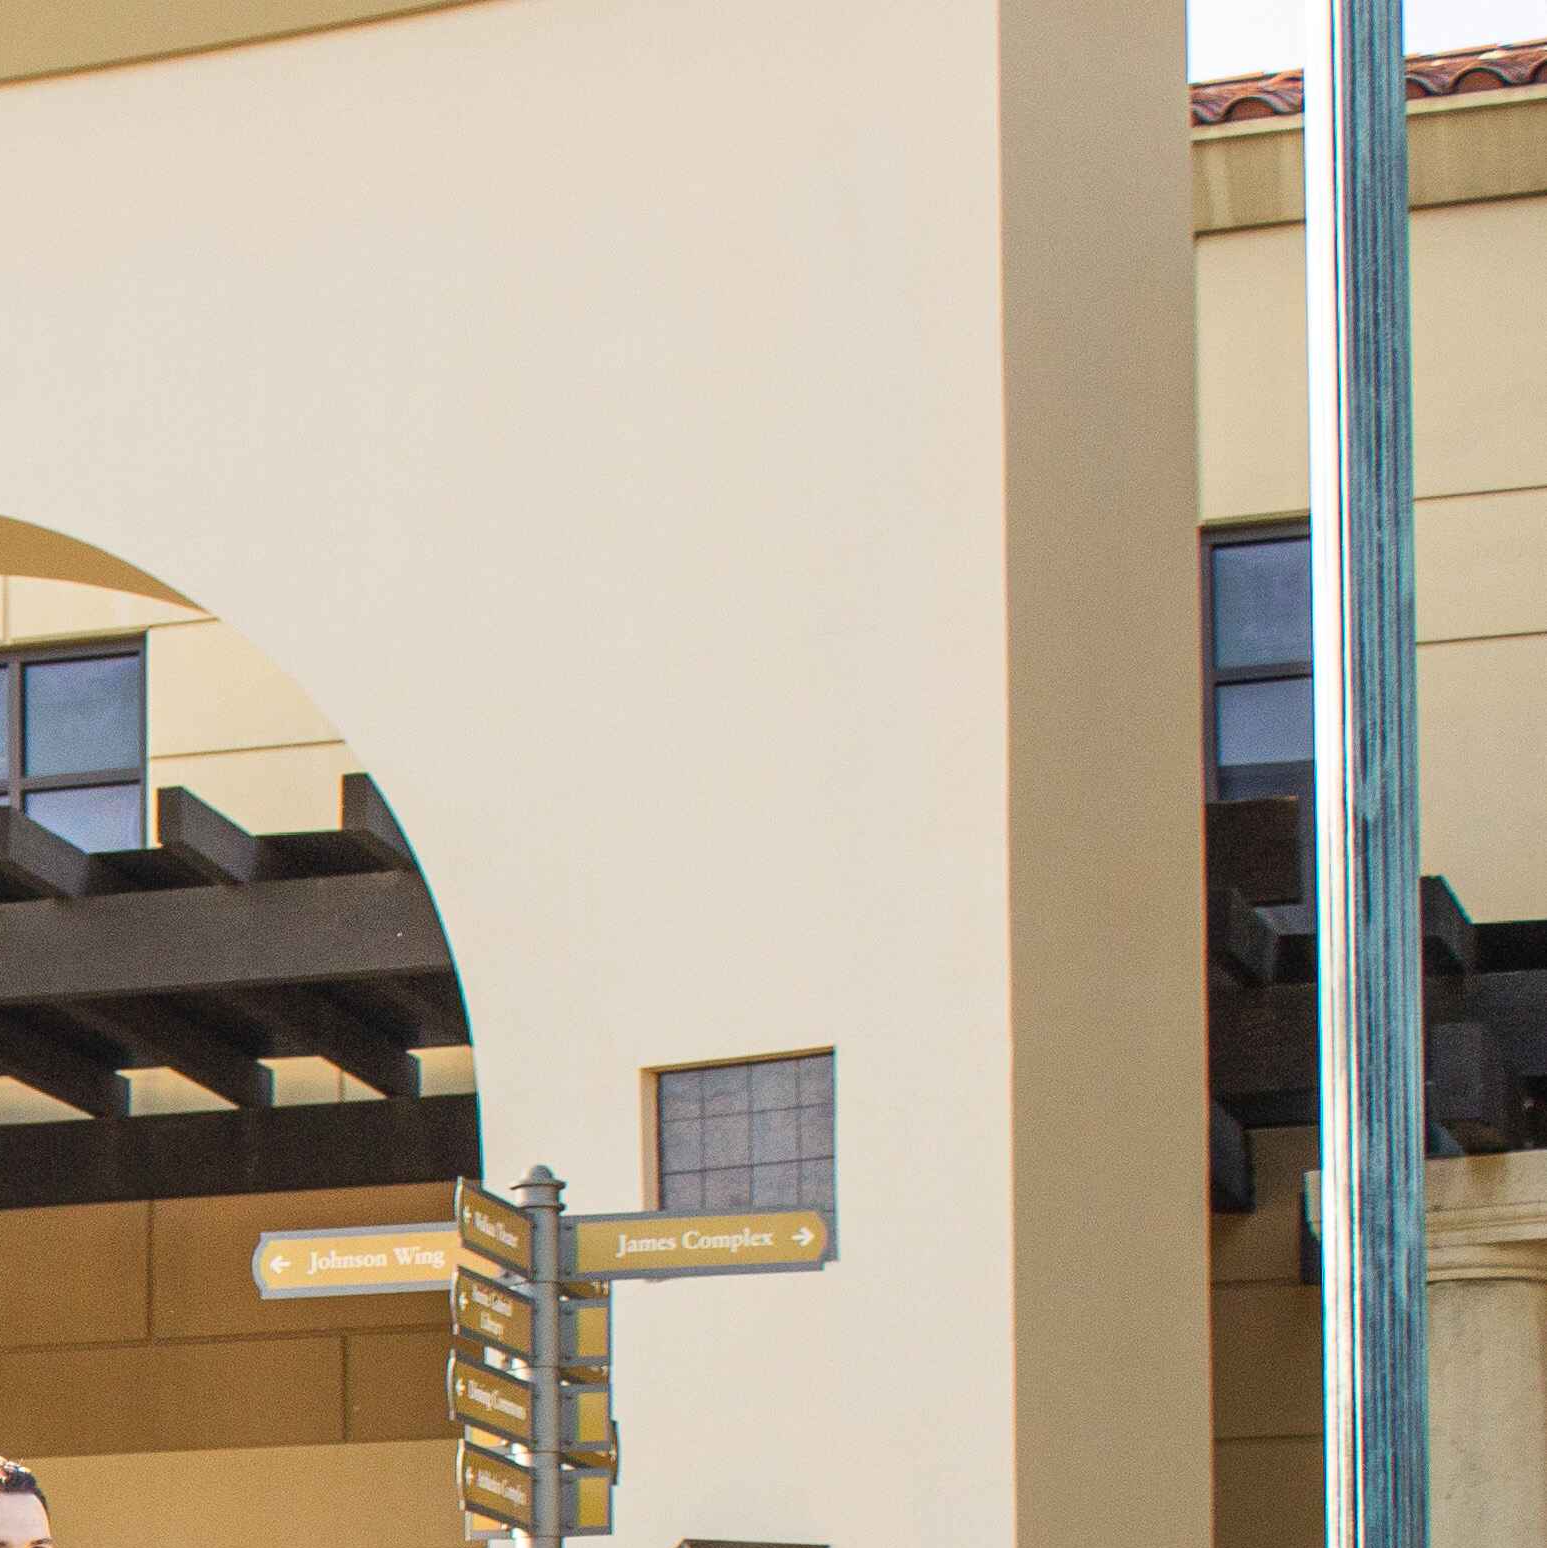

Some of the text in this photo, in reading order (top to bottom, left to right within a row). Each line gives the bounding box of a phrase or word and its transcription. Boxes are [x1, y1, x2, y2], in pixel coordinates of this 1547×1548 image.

[616, 1227, 773, 1258] James Complex
[307, 1246, 445, 1275] Johnson Wing
